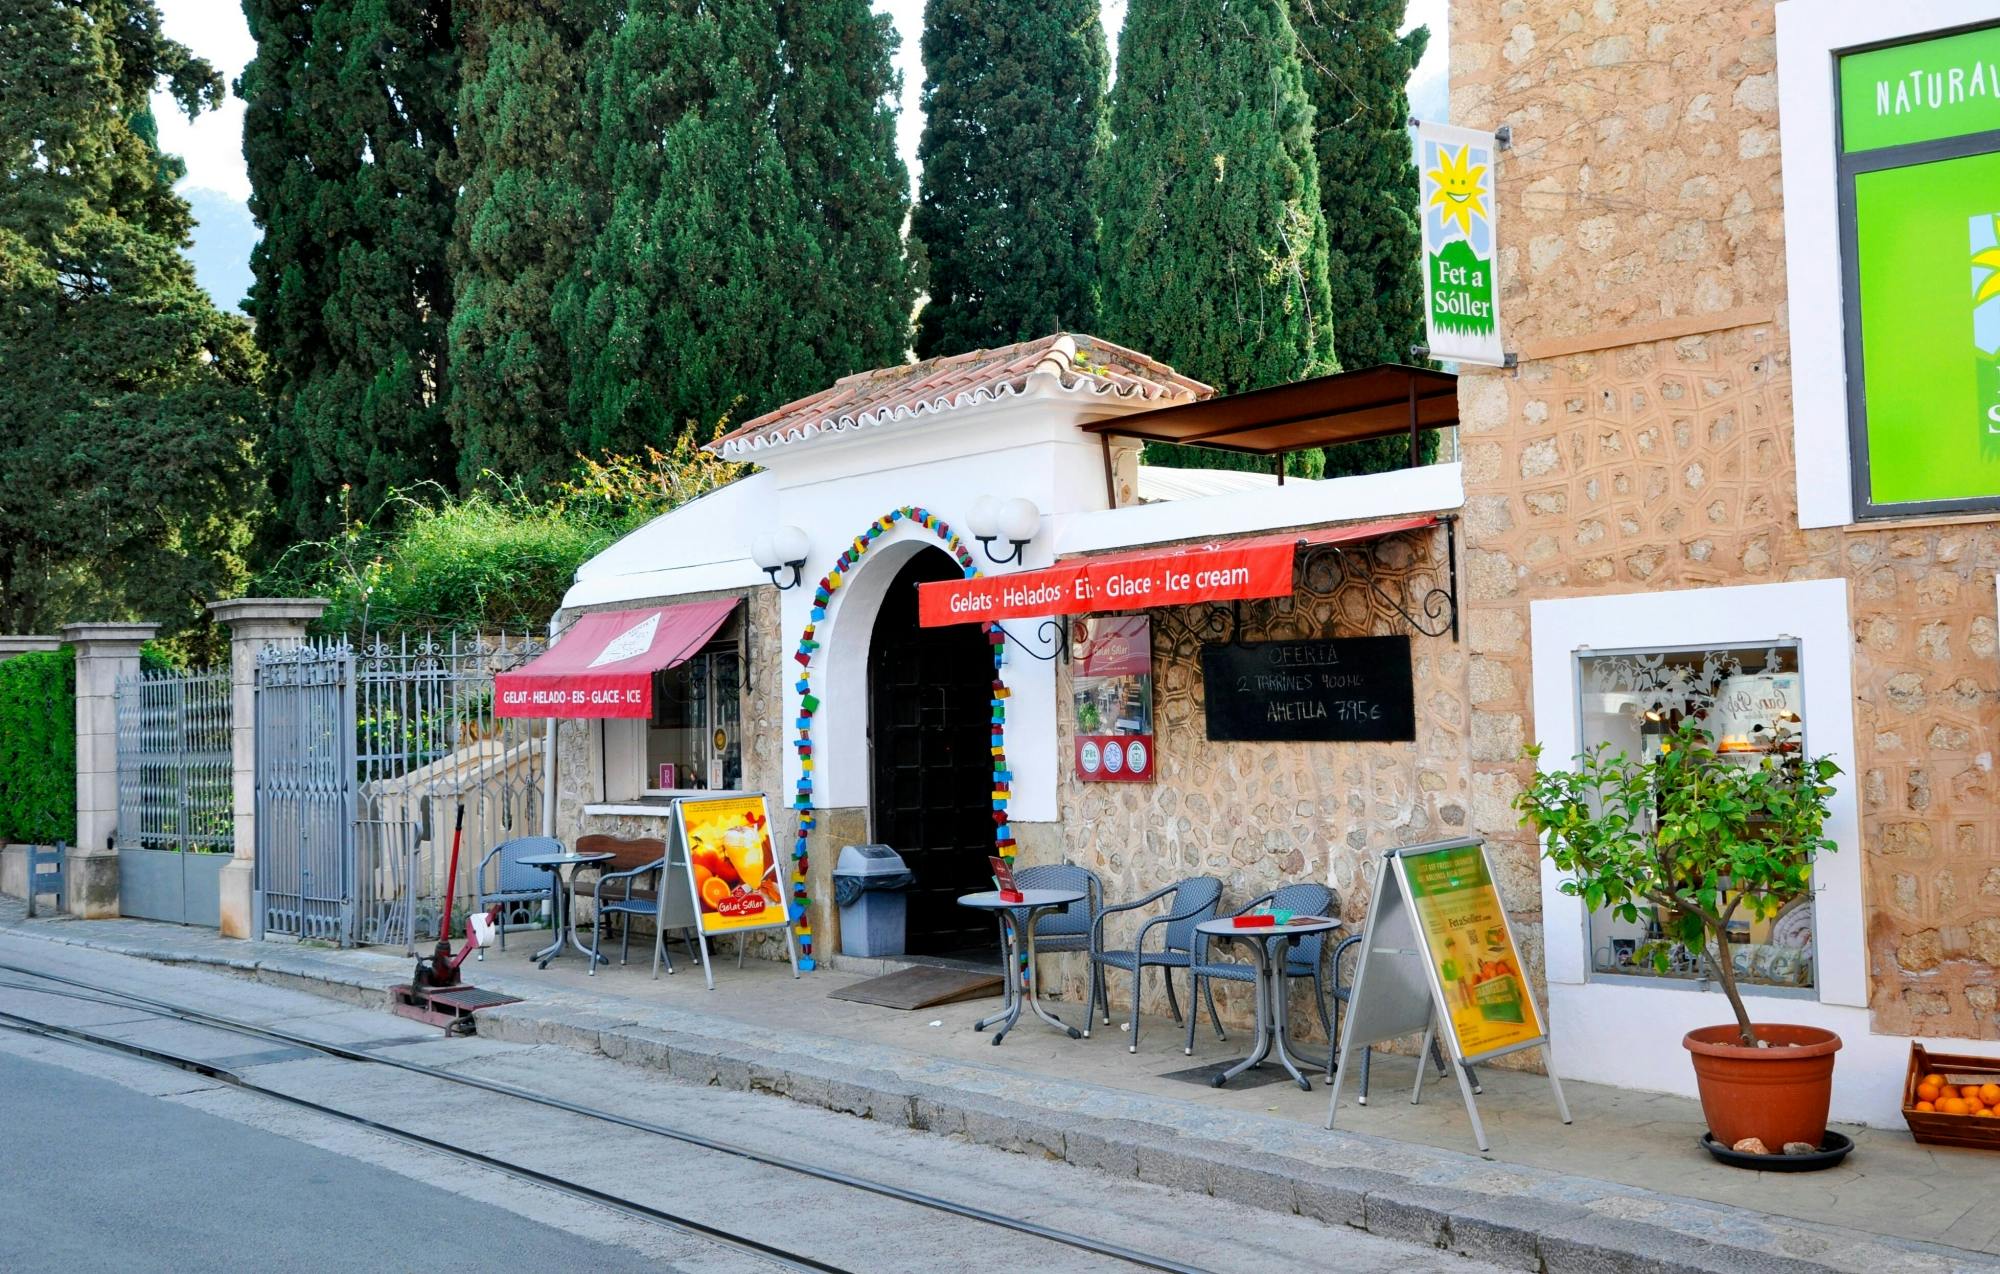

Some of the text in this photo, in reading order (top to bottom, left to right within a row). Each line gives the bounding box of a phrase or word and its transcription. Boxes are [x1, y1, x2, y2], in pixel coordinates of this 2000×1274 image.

[1438, 261, 1483, 288] Fet a
[1435, 290, 1490, 318] Sóller
[950, 591, 992, 613] Gelats
[1003, 582, 1061, 608] Helados
[1106, 574, 1152, 597] Glace
[1165, 570, 1190, 592] Ice
[1195, 567, 1249, 589] cream
[1268, 645, 1338, 665] OFERTA
[1236, 676, 1250, 692] 2
[503, 689, 641, 704] GELAT HELADO EIS GLACE ICE
